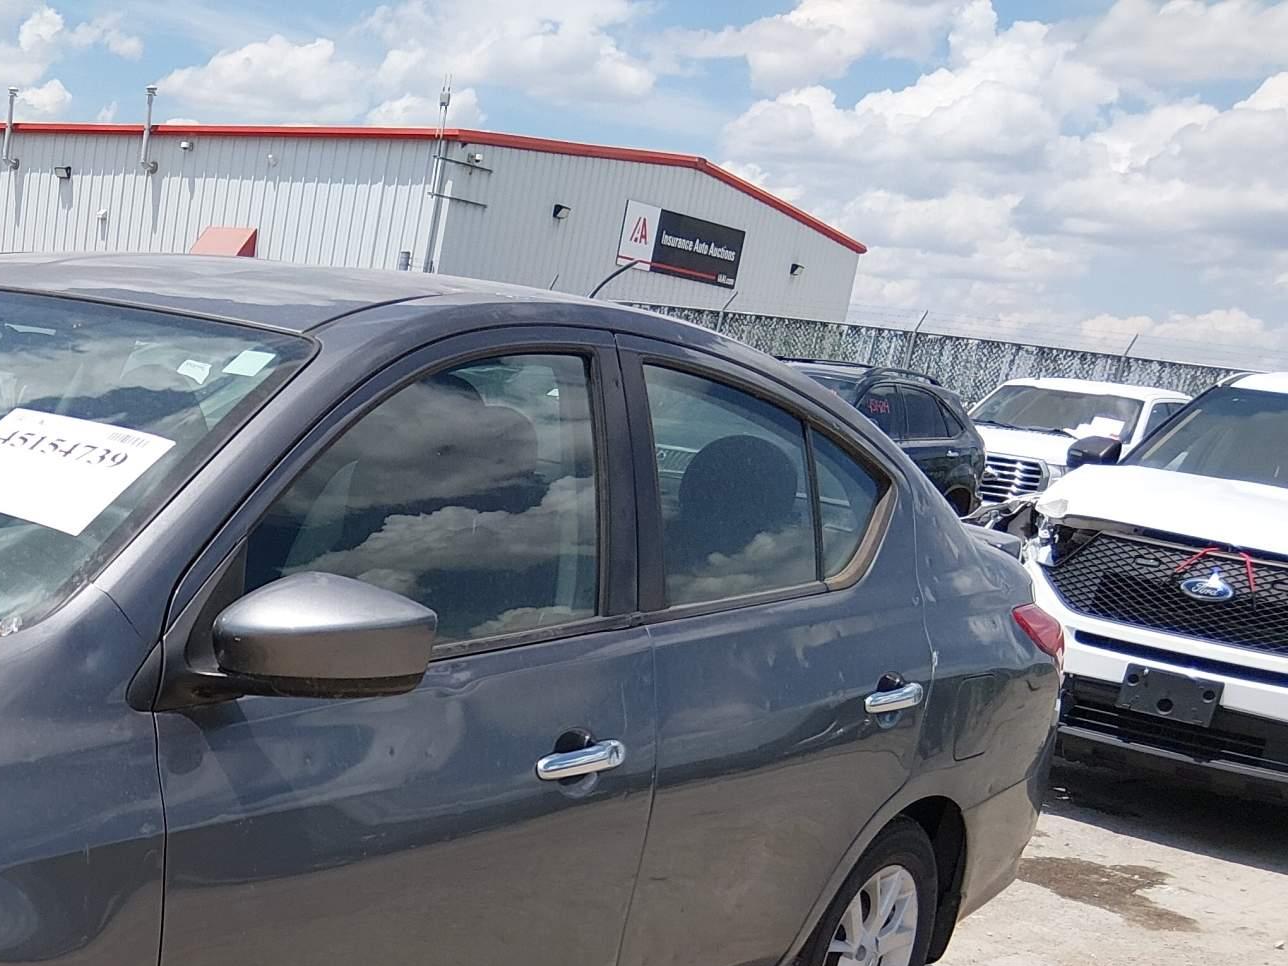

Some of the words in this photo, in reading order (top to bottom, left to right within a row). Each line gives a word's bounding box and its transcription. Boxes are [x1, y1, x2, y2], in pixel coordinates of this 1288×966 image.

[661, 230, 694, 251] Insurance
[693, 238, 709, 255] Auto
[708, 242, 737, 262] Auctions
